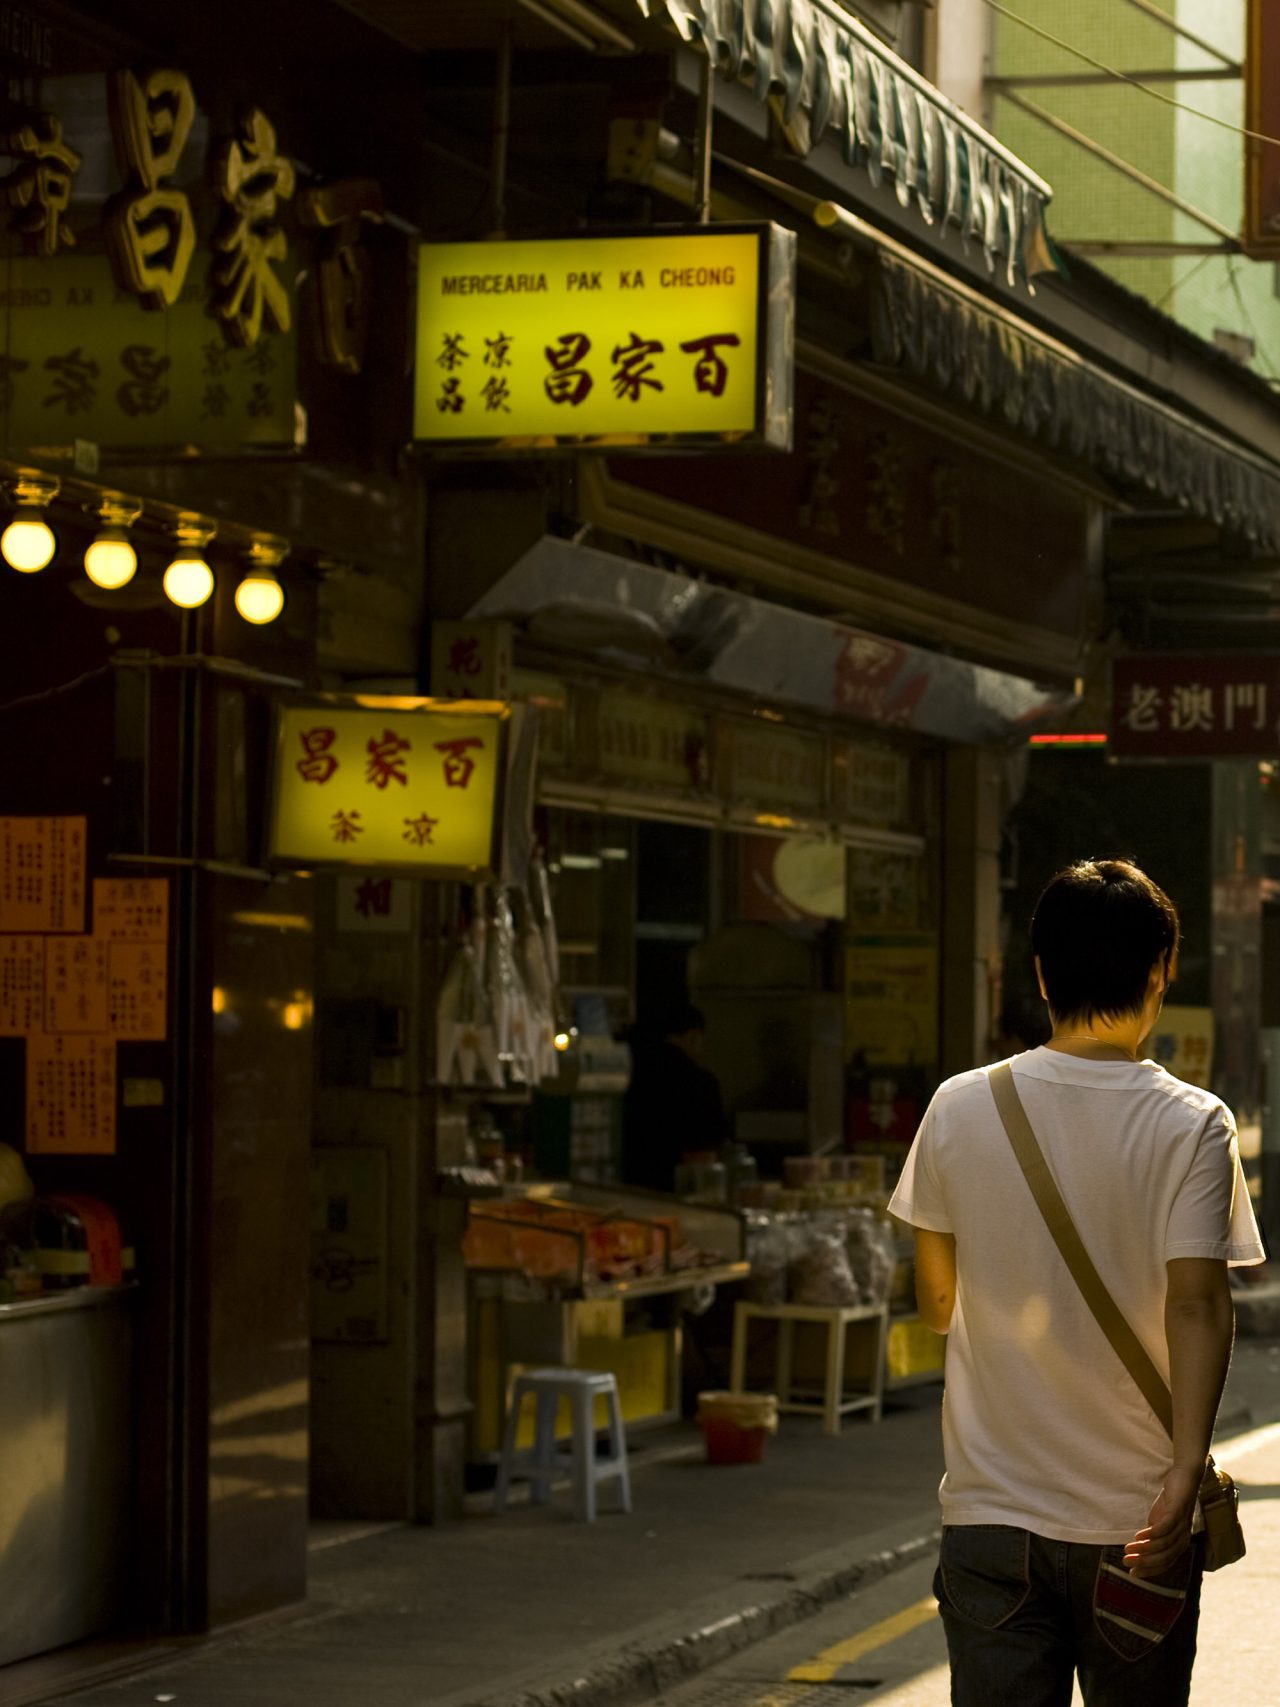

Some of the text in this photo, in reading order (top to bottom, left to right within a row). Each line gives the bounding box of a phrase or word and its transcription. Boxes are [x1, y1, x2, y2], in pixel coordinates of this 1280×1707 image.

[441, 266, 736, 295] MERCEARIA PAK KA CHEONG
